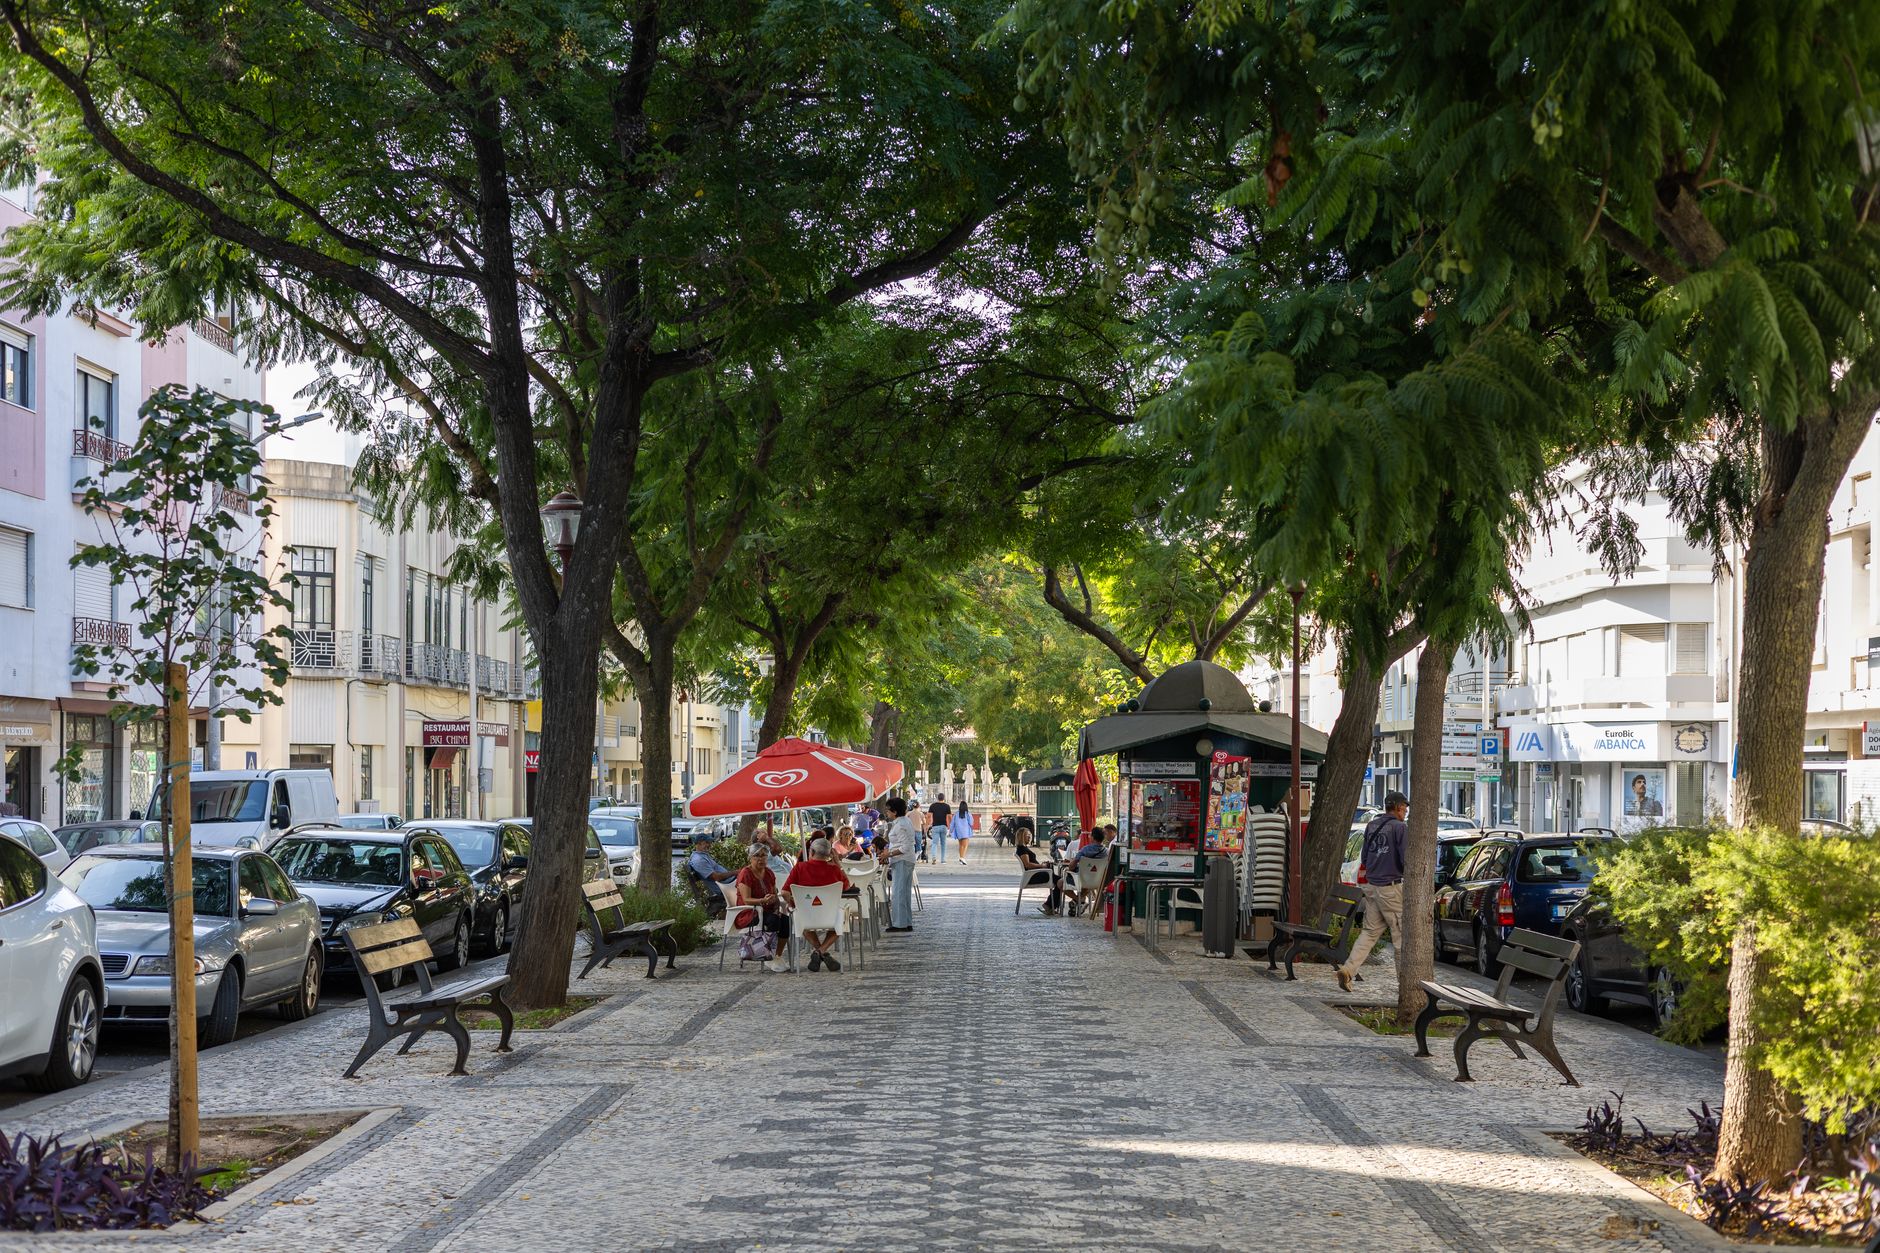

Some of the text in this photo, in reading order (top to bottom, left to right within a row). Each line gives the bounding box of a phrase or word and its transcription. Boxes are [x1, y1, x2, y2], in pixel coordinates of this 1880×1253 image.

[1605, 730, 1634, 738] EuroBic
[1484, 740, 1497, 754] P
[764, 796, 789, 810] OLÁ
